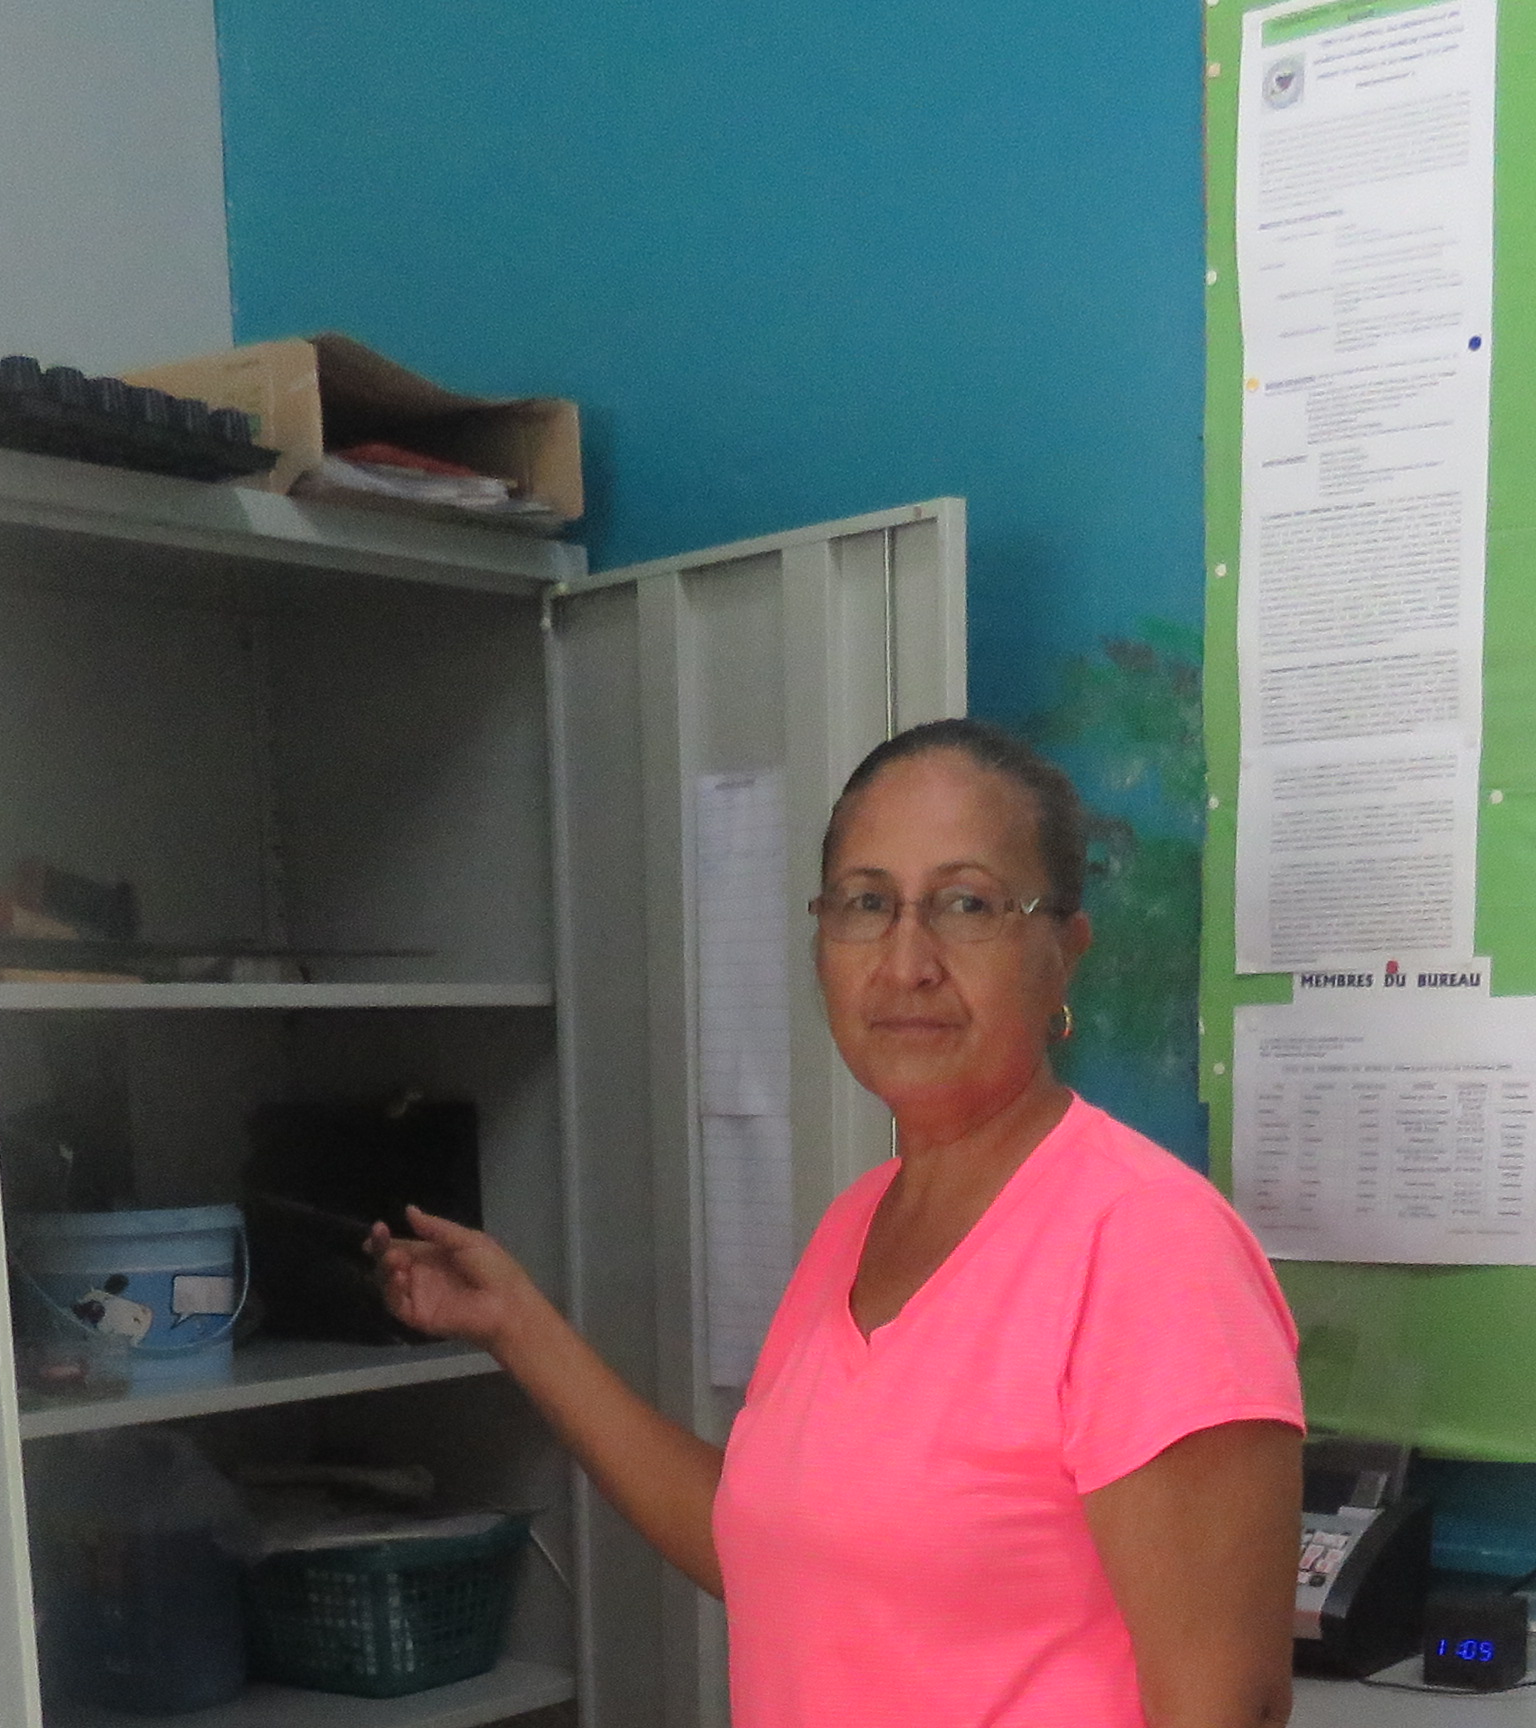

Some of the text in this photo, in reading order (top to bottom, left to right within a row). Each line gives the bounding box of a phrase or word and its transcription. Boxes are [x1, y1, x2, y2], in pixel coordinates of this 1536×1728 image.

[1300, 972, 1482, 989] MEMBRES DU BUREAU
